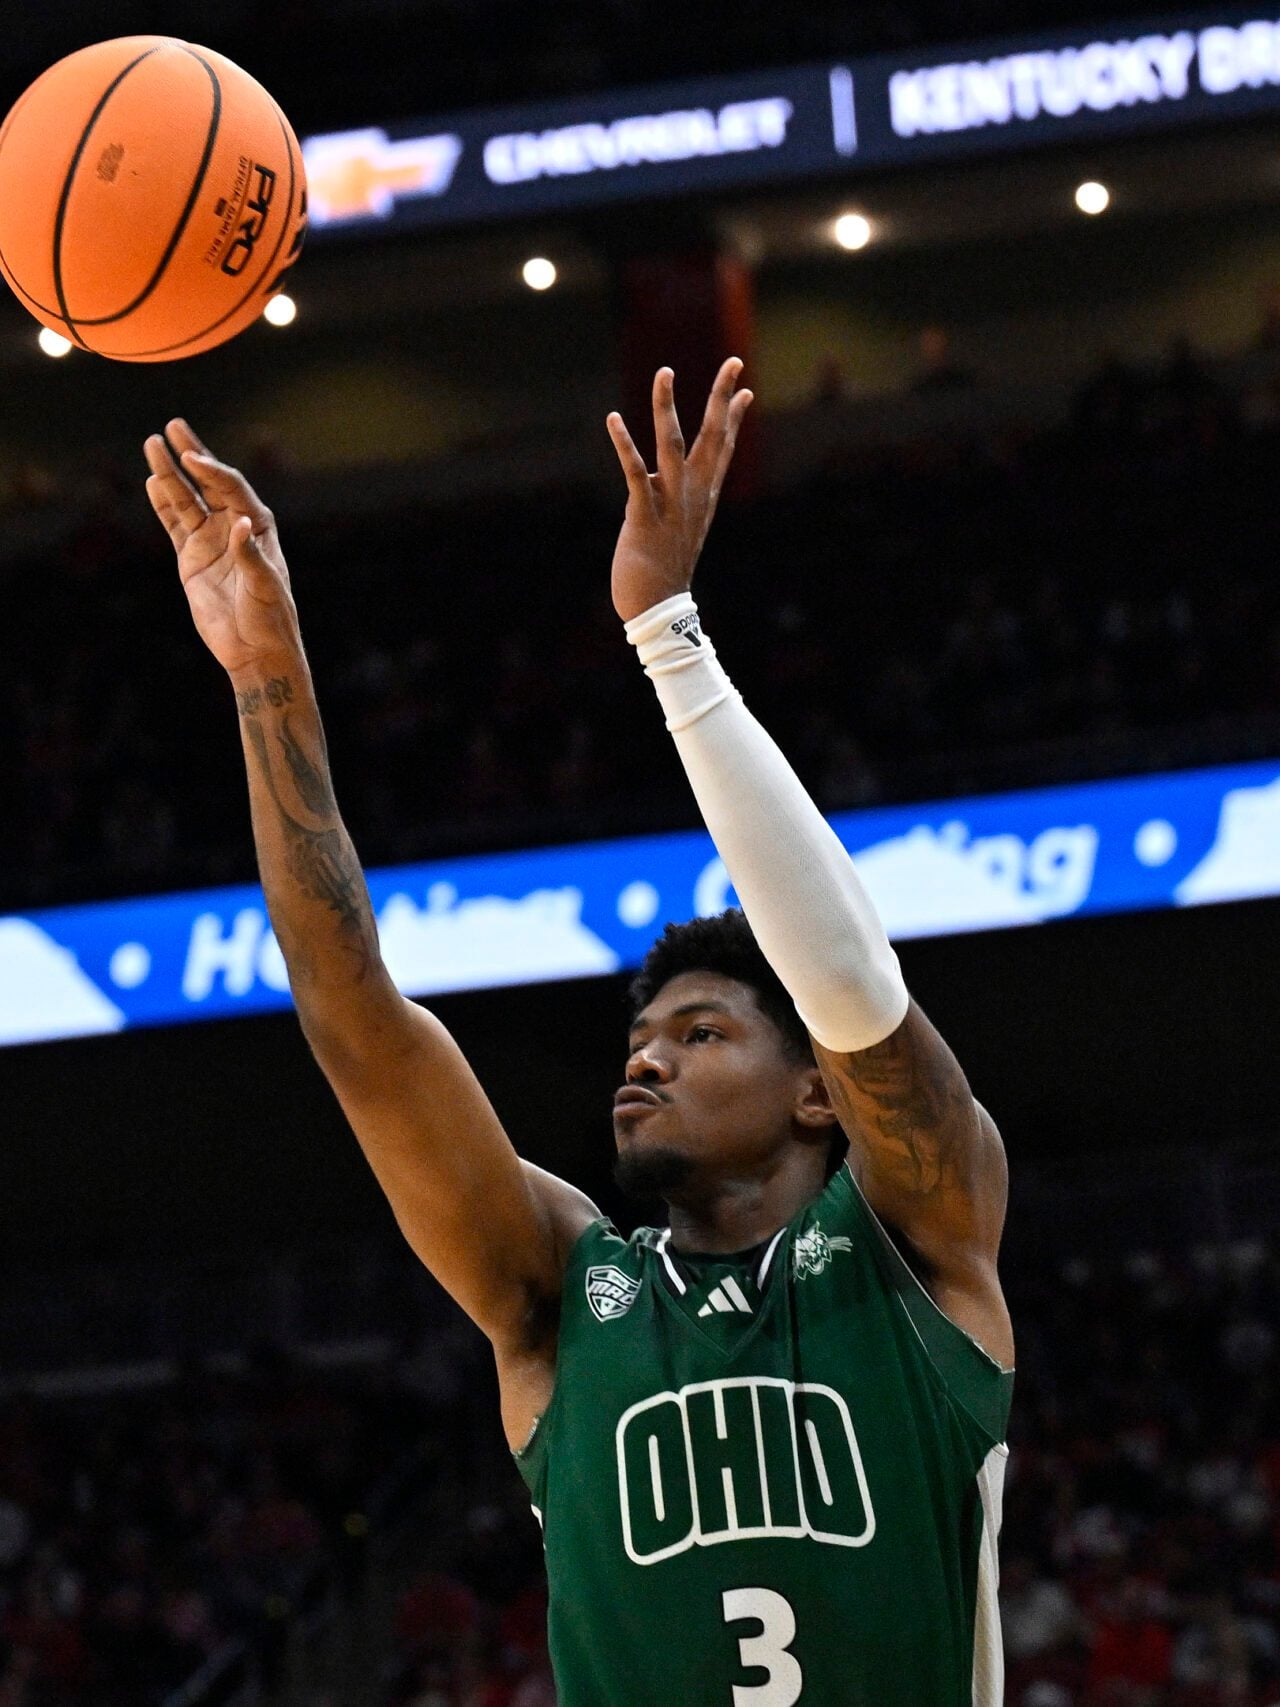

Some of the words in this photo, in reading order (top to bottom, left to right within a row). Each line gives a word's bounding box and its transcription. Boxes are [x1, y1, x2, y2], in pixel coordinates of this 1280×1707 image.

[888, 31, 1196, 138] KENTUCKY
[484, 97, 794, 184] CHEVROLET
[221, 163, 277, 276] PRO
[588, 1280, 637, 1306] MAC
[616, 1376, 876, 1566] OHIO
[722, 1587, 803, 1707] 3
